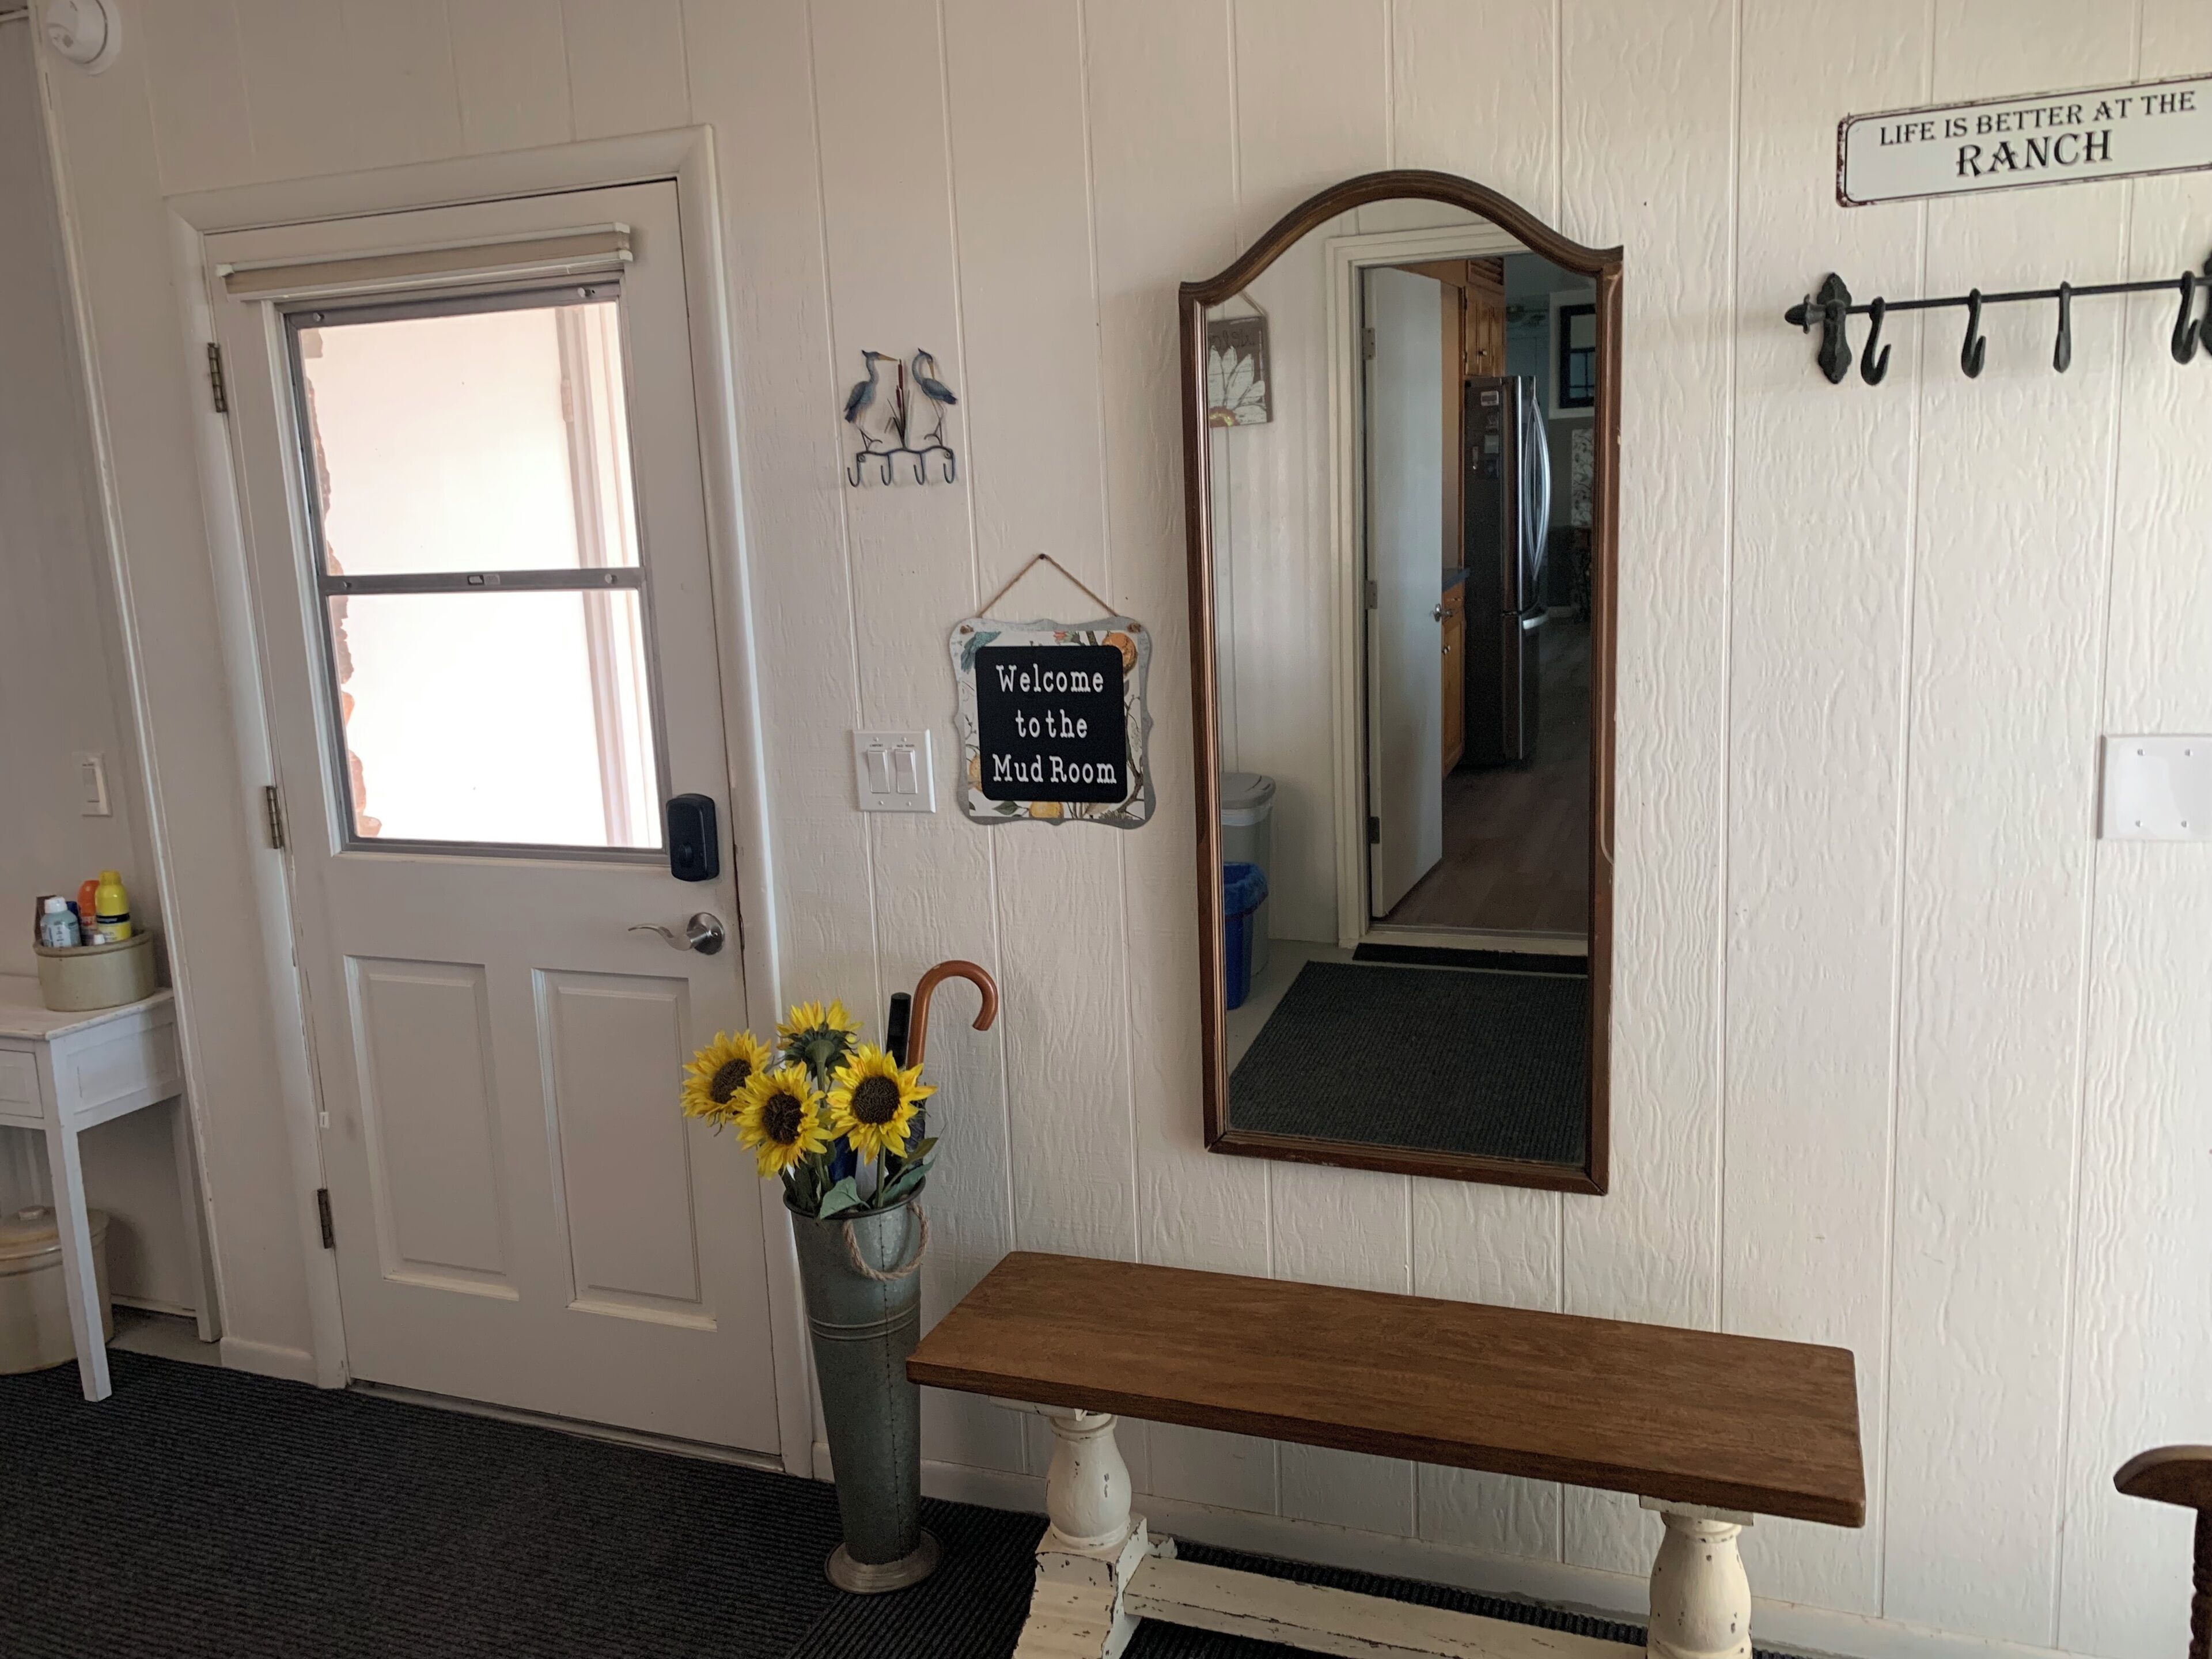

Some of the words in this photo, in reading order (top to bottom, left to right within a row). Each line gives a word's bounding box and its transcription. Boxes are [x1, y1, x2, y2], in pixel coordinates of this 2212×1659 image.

[1880, 121, 1936, 146] LIFE
[1945, 118, 1967, 138] IS
[1976, 104, 2084, 135] BETTER
[2092, 97, 2133, 122] AT
[2141, 90, 2196, 115] THE
[1956, 129, 2113, 177] RANCH
[995, 663, 1104, 692] Welcome
[1015, 709, 1040, 738] to
[1046, 709, 1088, 738] the
[992, 753, 1044, 783] Mud
[1049, 755, 1117, 784] Room
